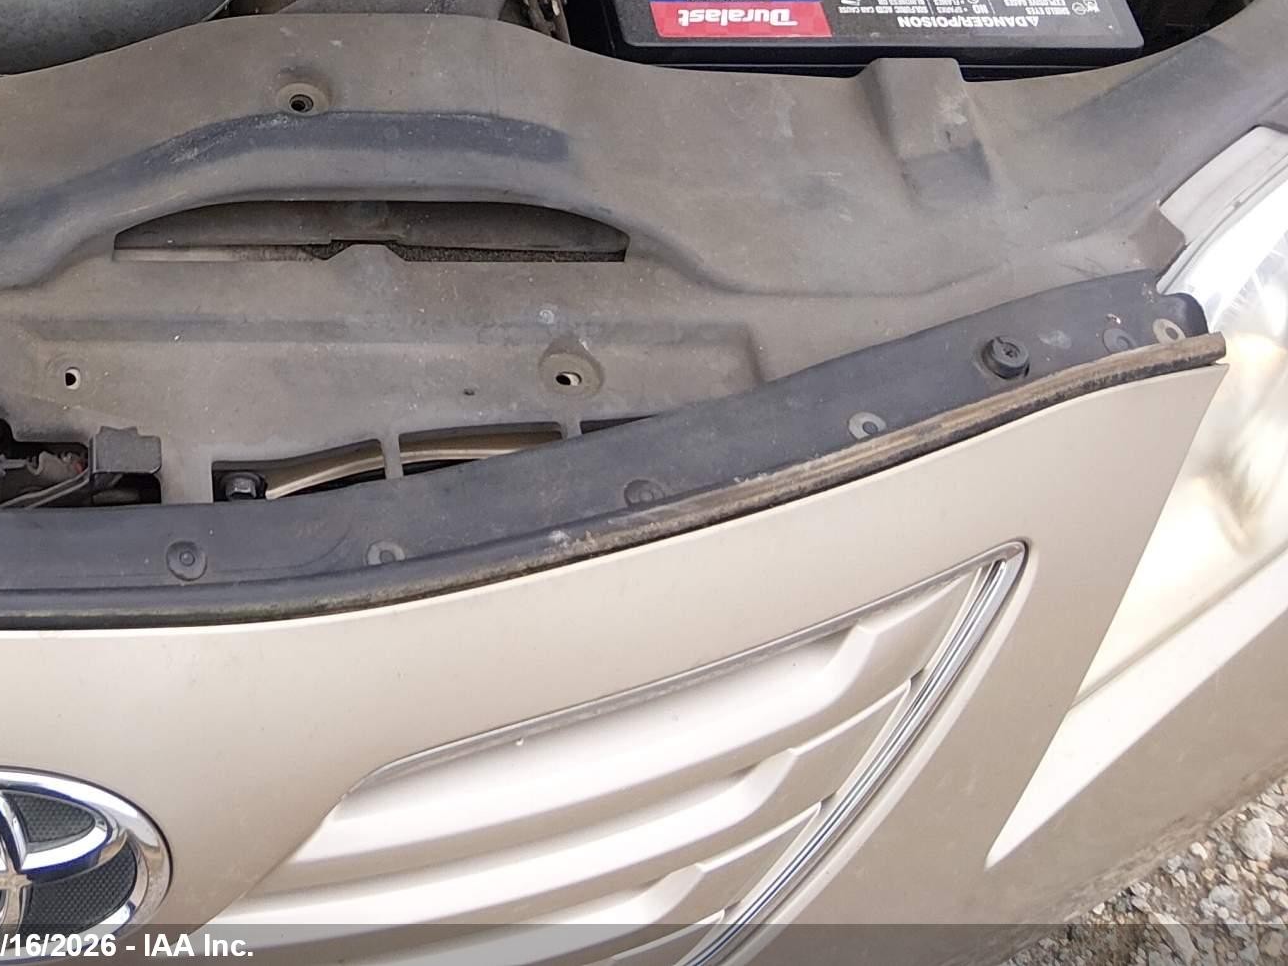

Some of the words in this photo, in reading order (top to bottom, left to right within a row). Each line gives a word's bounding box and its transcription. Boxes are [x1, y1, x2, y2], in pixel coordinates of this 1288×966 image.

[972, 4, 989, 14] NO
[1025, 7, 1046, 15] EYES
[677, 8, 799, 27] Duralast
[897, 15, 1028, 27] DANGER/POISON
